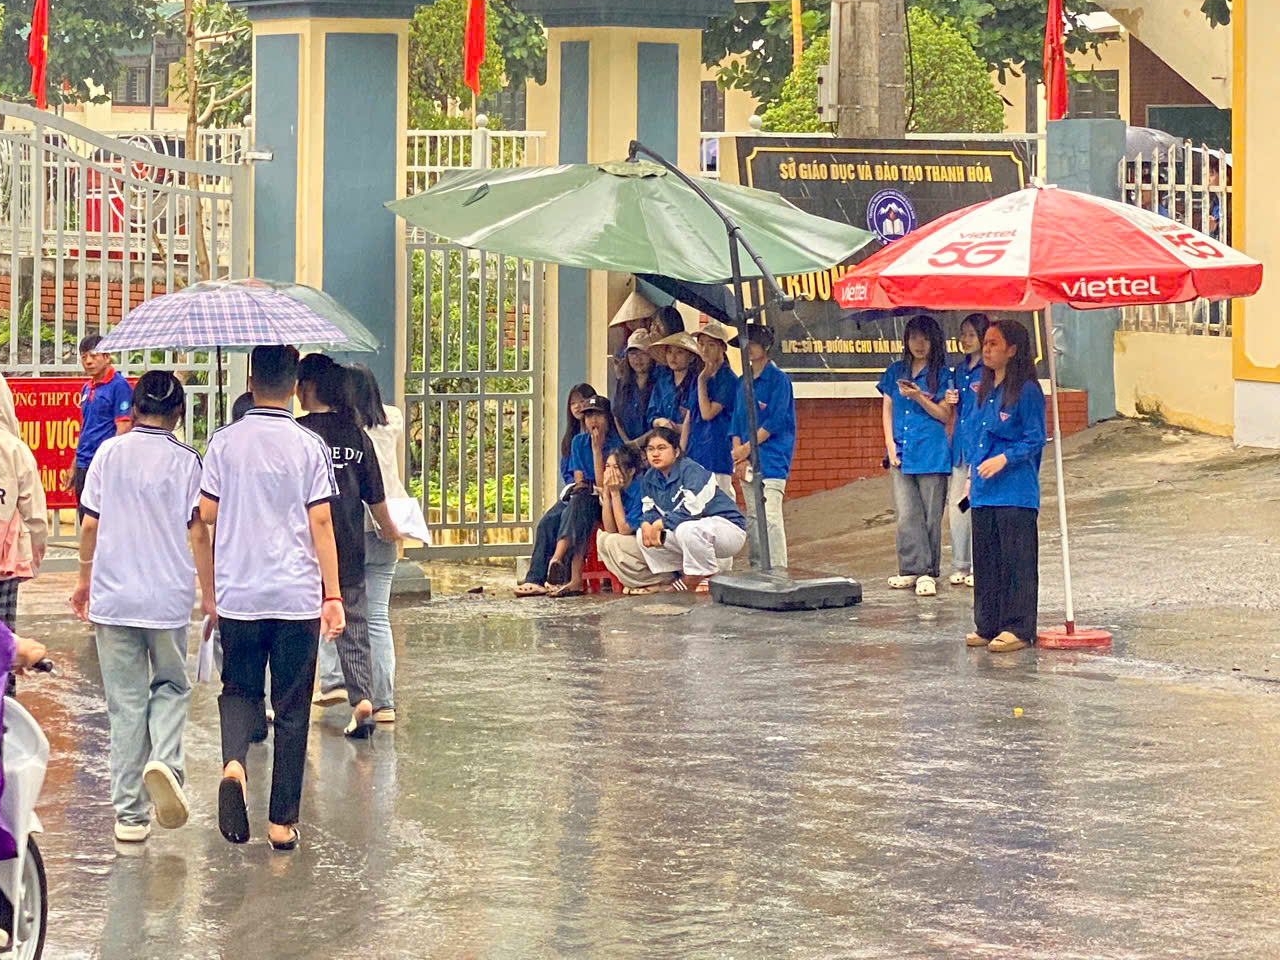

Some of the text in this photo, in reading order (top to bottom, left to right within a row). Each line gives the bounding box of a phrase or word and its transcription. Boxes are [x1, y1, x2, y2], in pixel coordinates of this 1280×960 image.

[779, 157, 993, 184] SỞ GIÁO DỤC VÀ ĐÀO TẠO THANH HÓA
[928, 240, 1013, 269] 5G
[841, 283, 868, 301] viettel
[1061, 276, 1160, 298] viettel
[40, 391, 70, 406] THPT
[20, 418, 80, 455] HU VỰC
[41, 465, 56, 492] ÂN
